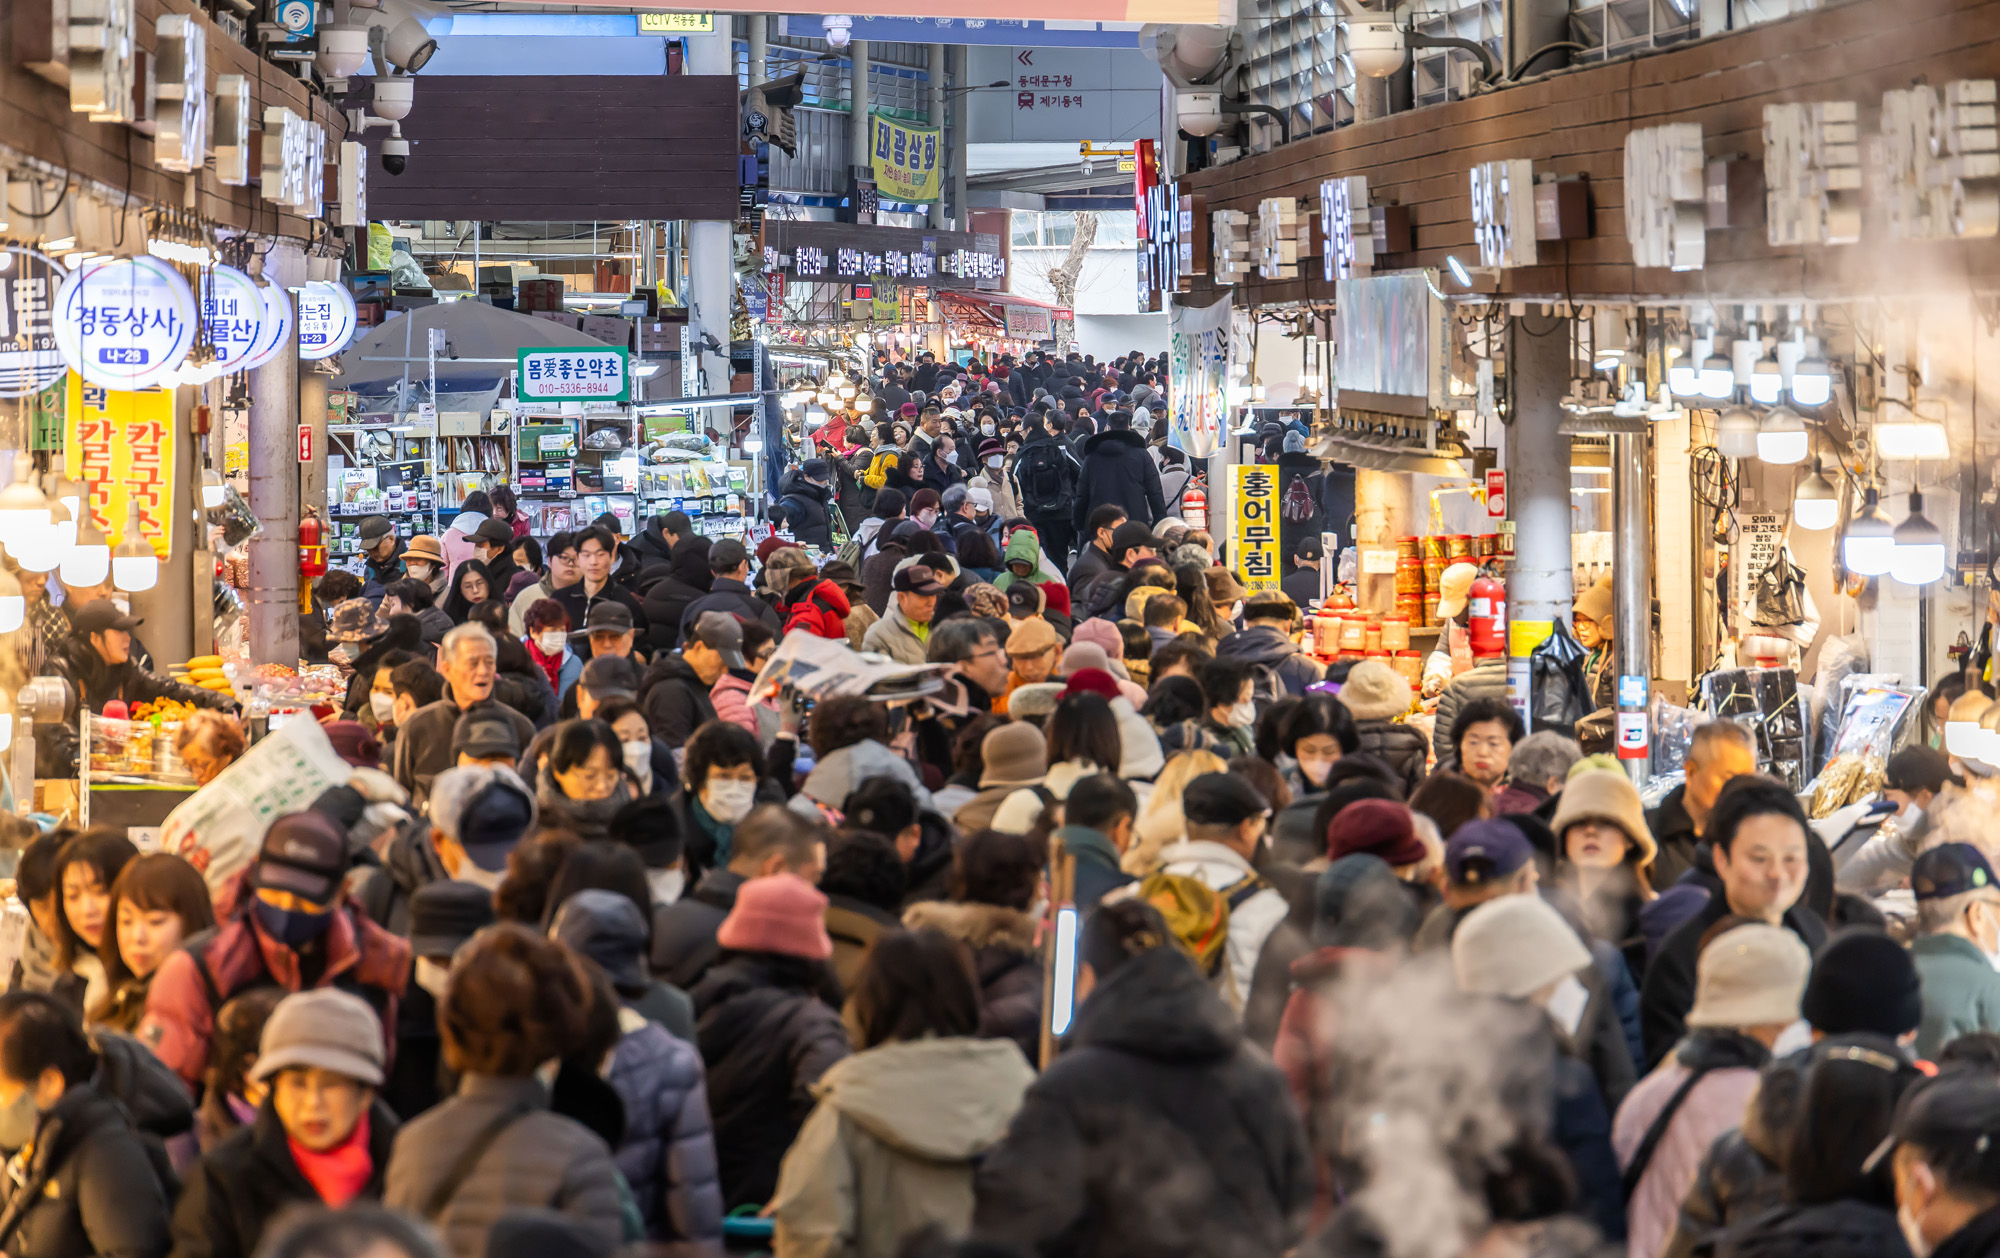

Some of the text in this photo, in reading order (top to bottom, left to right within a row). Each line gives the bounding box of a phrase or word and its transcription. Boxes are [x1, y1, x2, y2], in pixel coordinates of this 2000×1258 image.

[645, 13, 670, 25] CCTV
[1018, 74, 1073, 88] 동대문구청
[1039, 94, 1083, 109] 제기동역
[796, 245, 822, 277] 충남인삼
[74, 306, 177, 337] 경동상사
[301, 334, 322, 343] 나-23
[539, 382, 609, 394] 010-5336-8944
[1242, 472, 1274, 577] 홍어무침
[1751, 515, 1776, 524] 오이지
[1750, 543, 1775, 552] 갓김치
